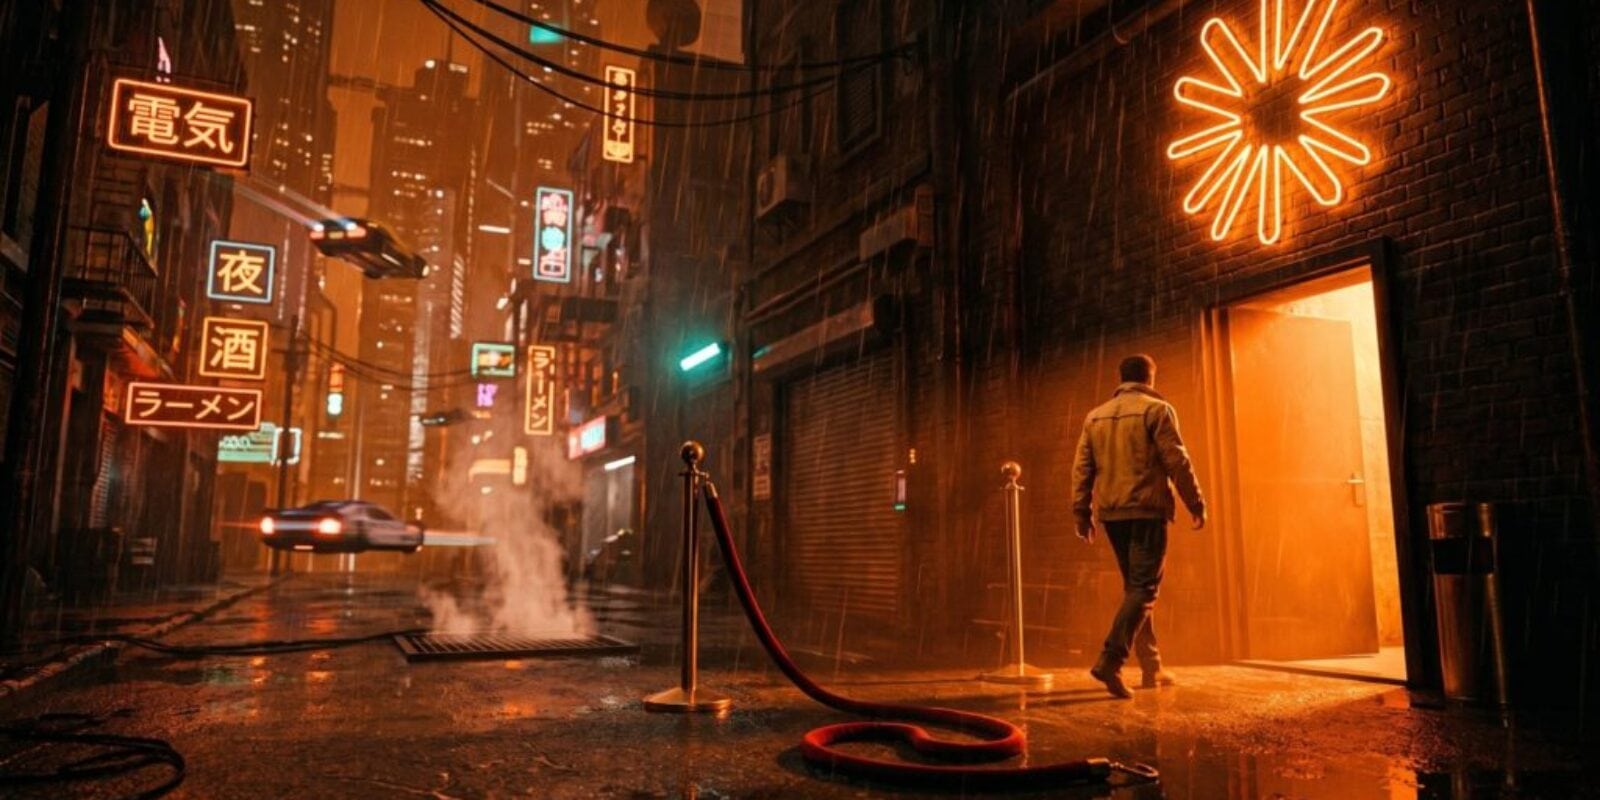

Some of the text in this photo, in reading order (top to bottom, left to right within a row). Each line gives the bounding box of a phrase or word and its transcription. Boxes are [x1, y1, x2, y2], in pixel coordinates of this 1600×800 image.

[129, 93, 236, 154] 電気
[217, 250, 265, 294] 夜
[210, 326, 259, 371] 酒
[135, 390, 255, 421] ラーメン
[532, 351, 550, 428] ラーメン
